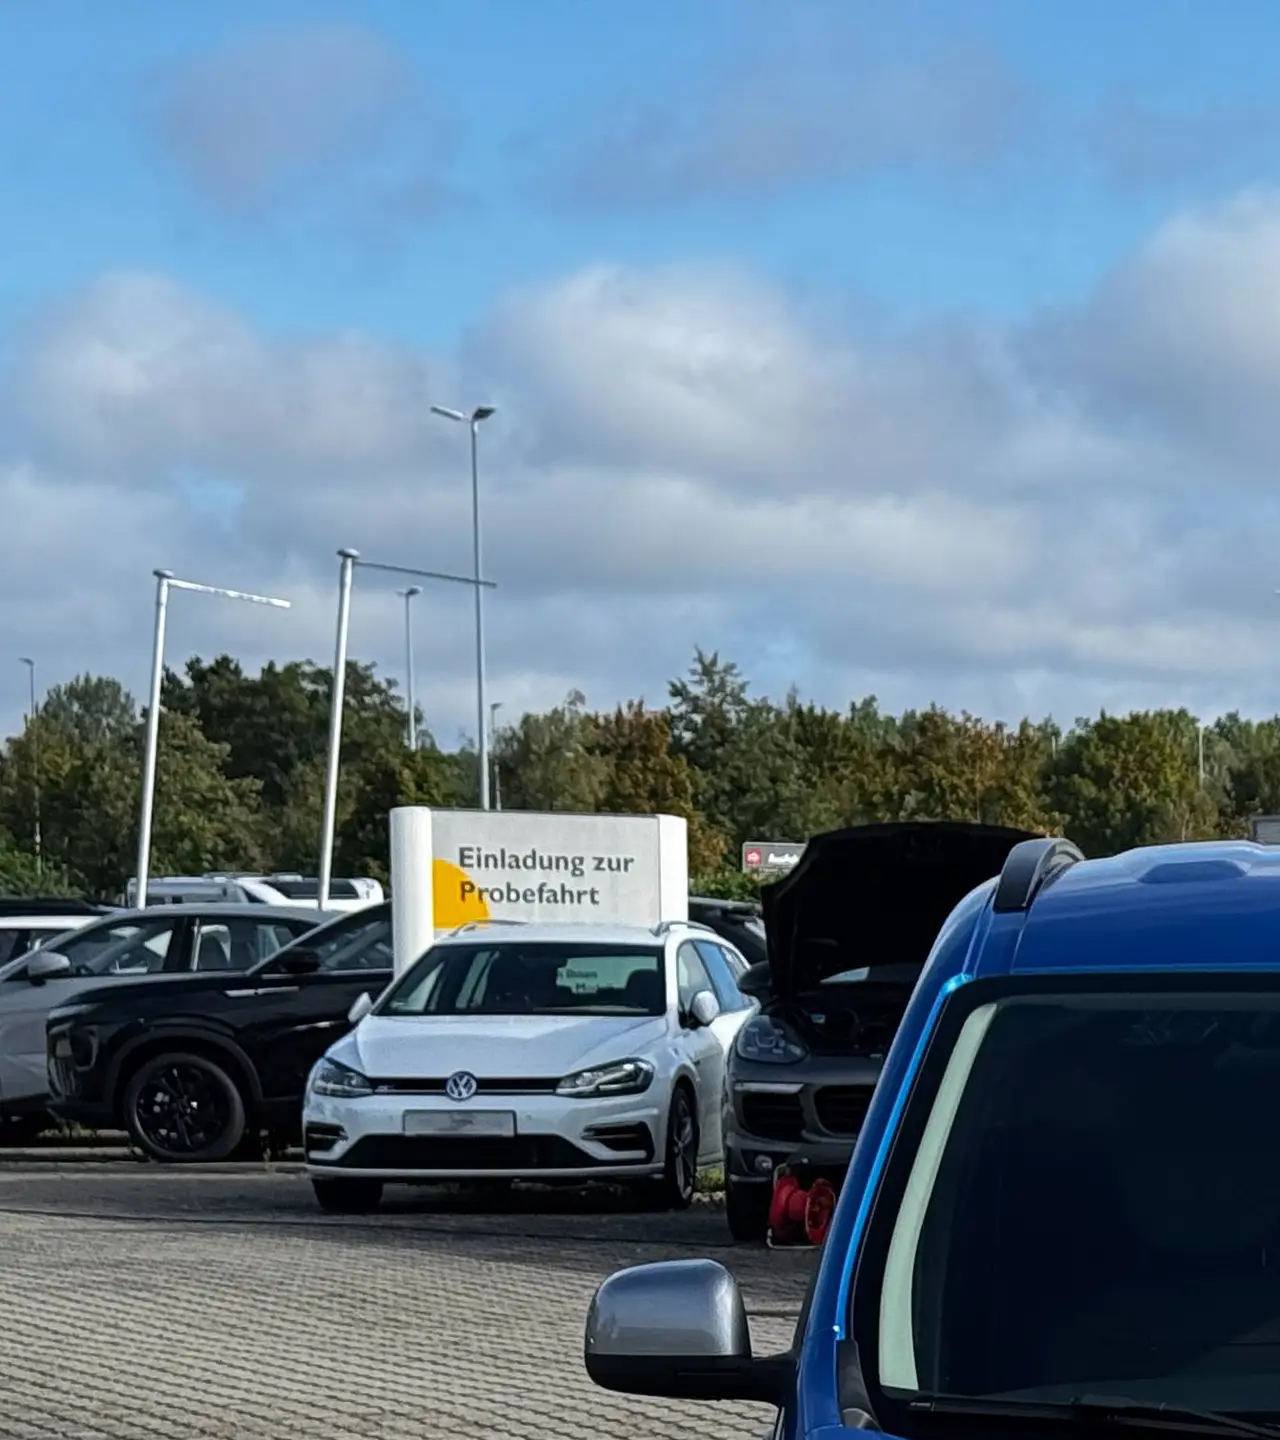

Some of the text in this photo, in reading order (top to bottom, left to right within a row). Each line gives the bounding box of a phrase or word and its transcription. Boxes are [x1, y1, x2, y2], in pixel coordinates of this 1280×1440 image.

[458, 846, 635, 877] Einladung zur
[459, 880, 600, 906] Probefahrt
